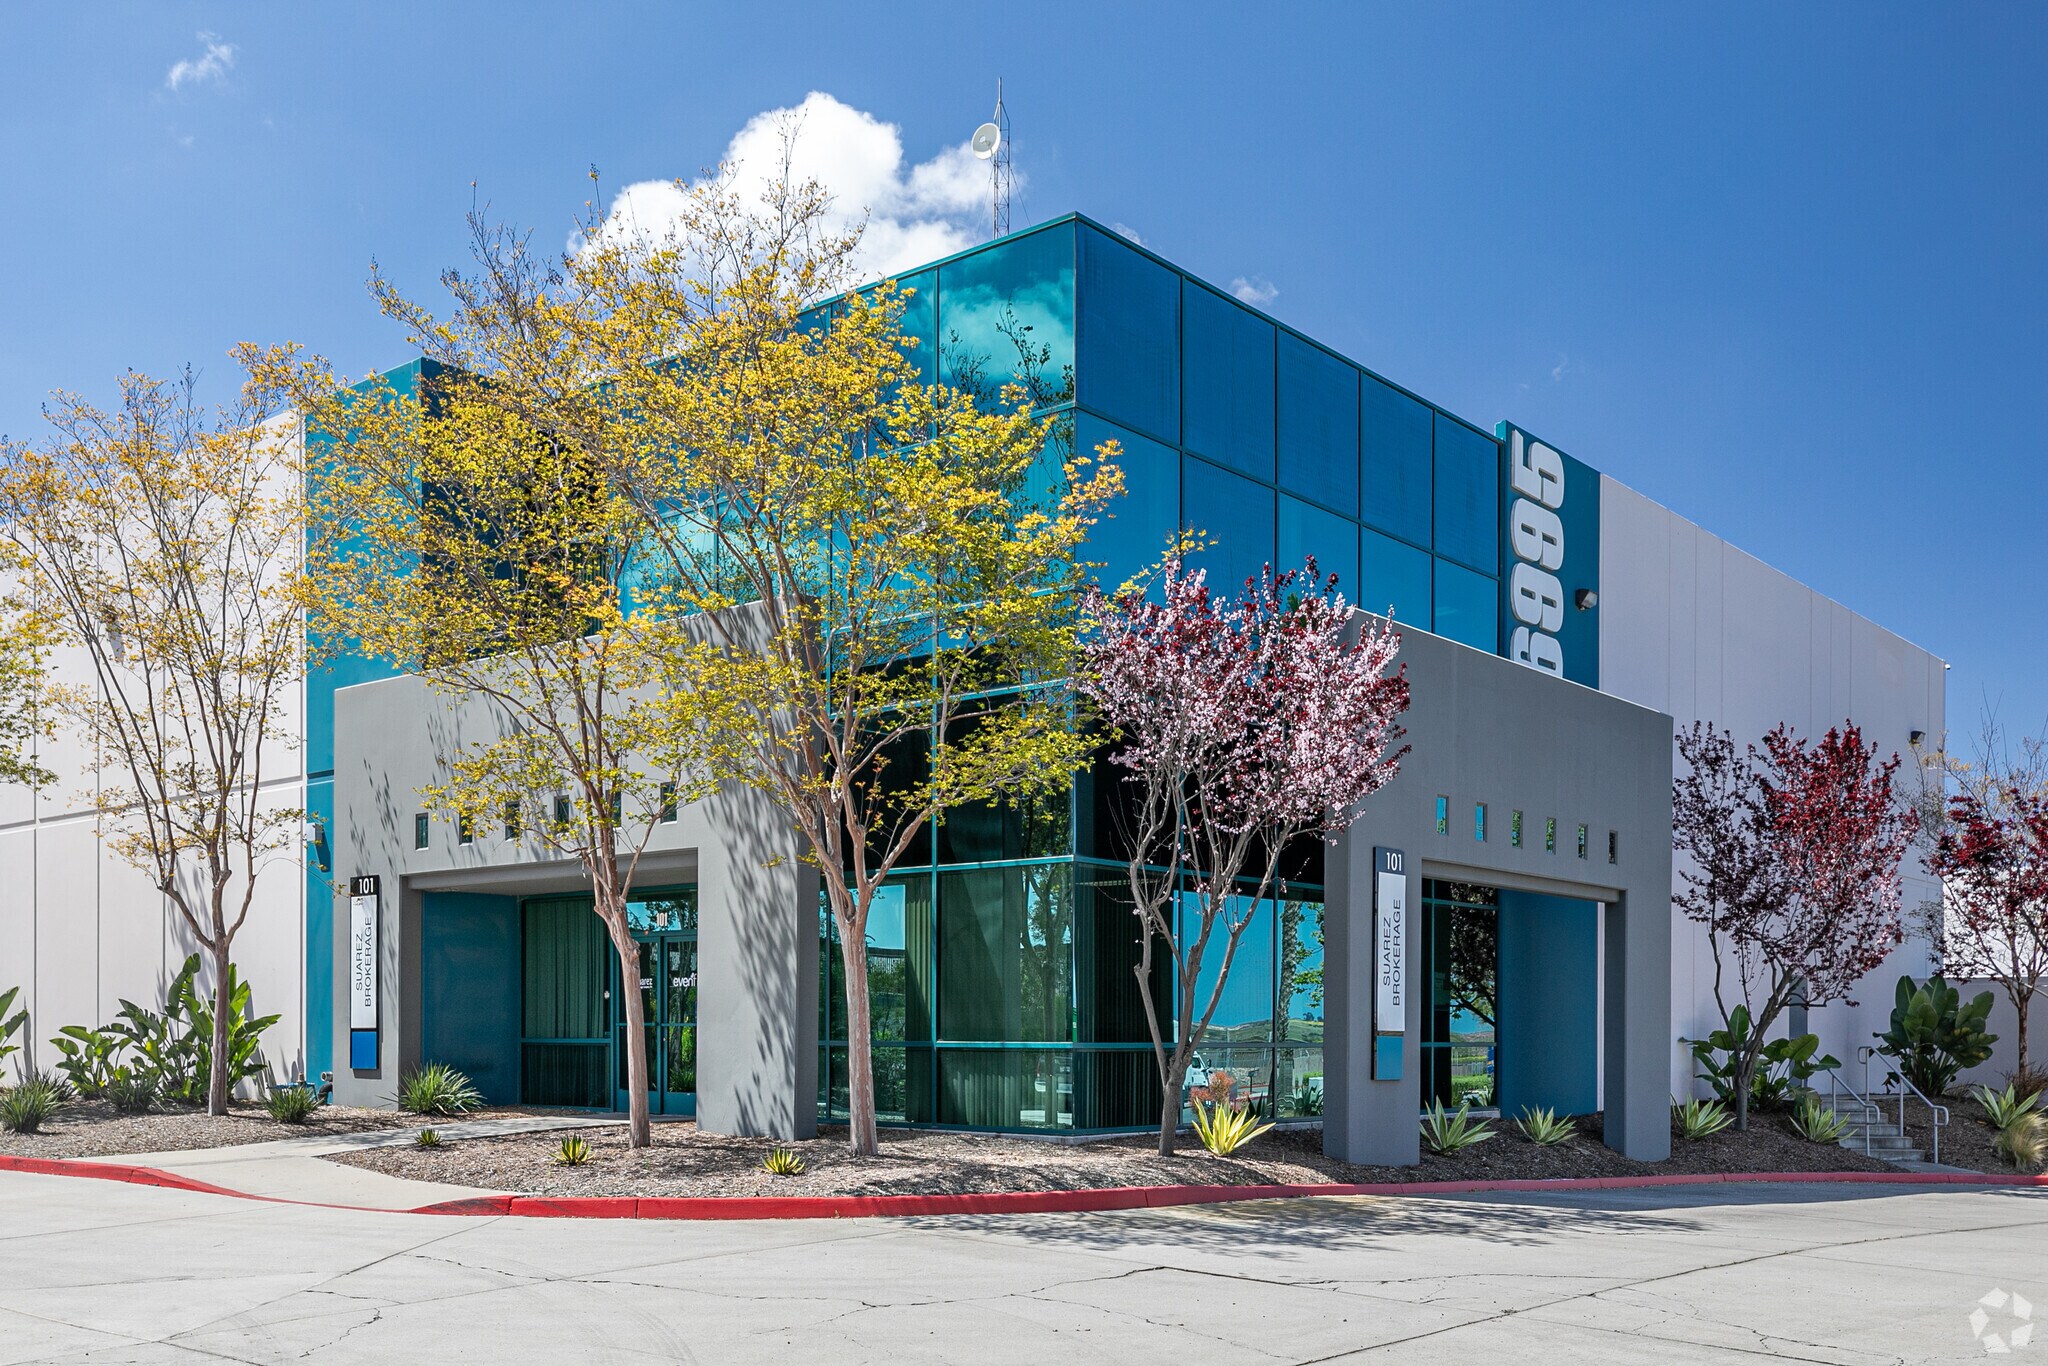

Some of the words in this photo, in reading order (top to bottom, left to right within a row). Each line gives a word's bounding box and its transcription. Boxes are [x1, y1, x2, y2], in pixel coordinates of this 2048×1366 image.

[1510, 429, 1565, 679] 6995
[358, 877, 374, 894] 101
[1386, 852, 1402, 872] 101
[656, 912, 668, 926] 101
[1383, 917, 1391, 986] SUAREZ
[1392, 899, 1401, 1006] BROKERAGE
[364, 917, 372, 1007] BROKERAGE
